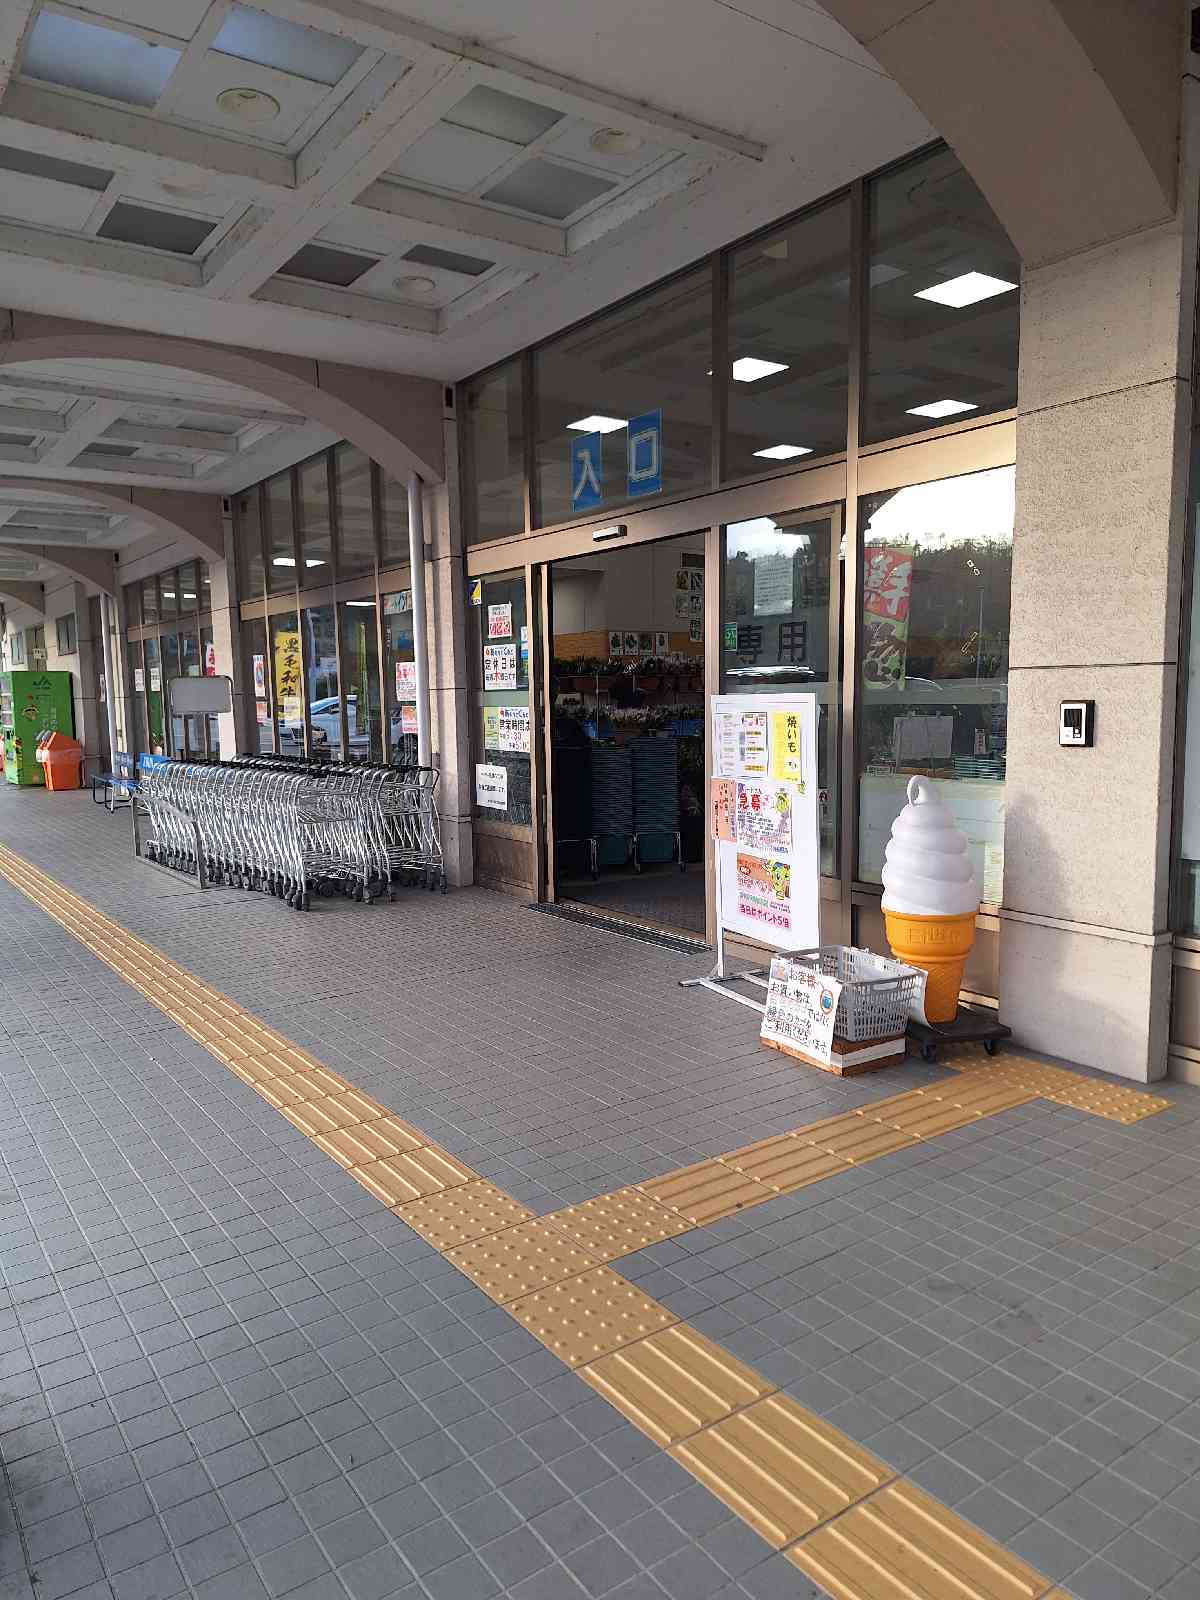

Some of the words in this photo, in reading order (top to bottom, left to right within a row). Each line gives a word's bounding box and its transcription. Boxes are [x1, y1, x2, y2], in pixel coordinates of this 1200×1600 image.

[575, 428, 658, 500] 入口
[280, 637, 299, 697] 黒毛和牛
[485, 656, 516, 670] 定休日は
[738, 793, 760, 811] 急募
